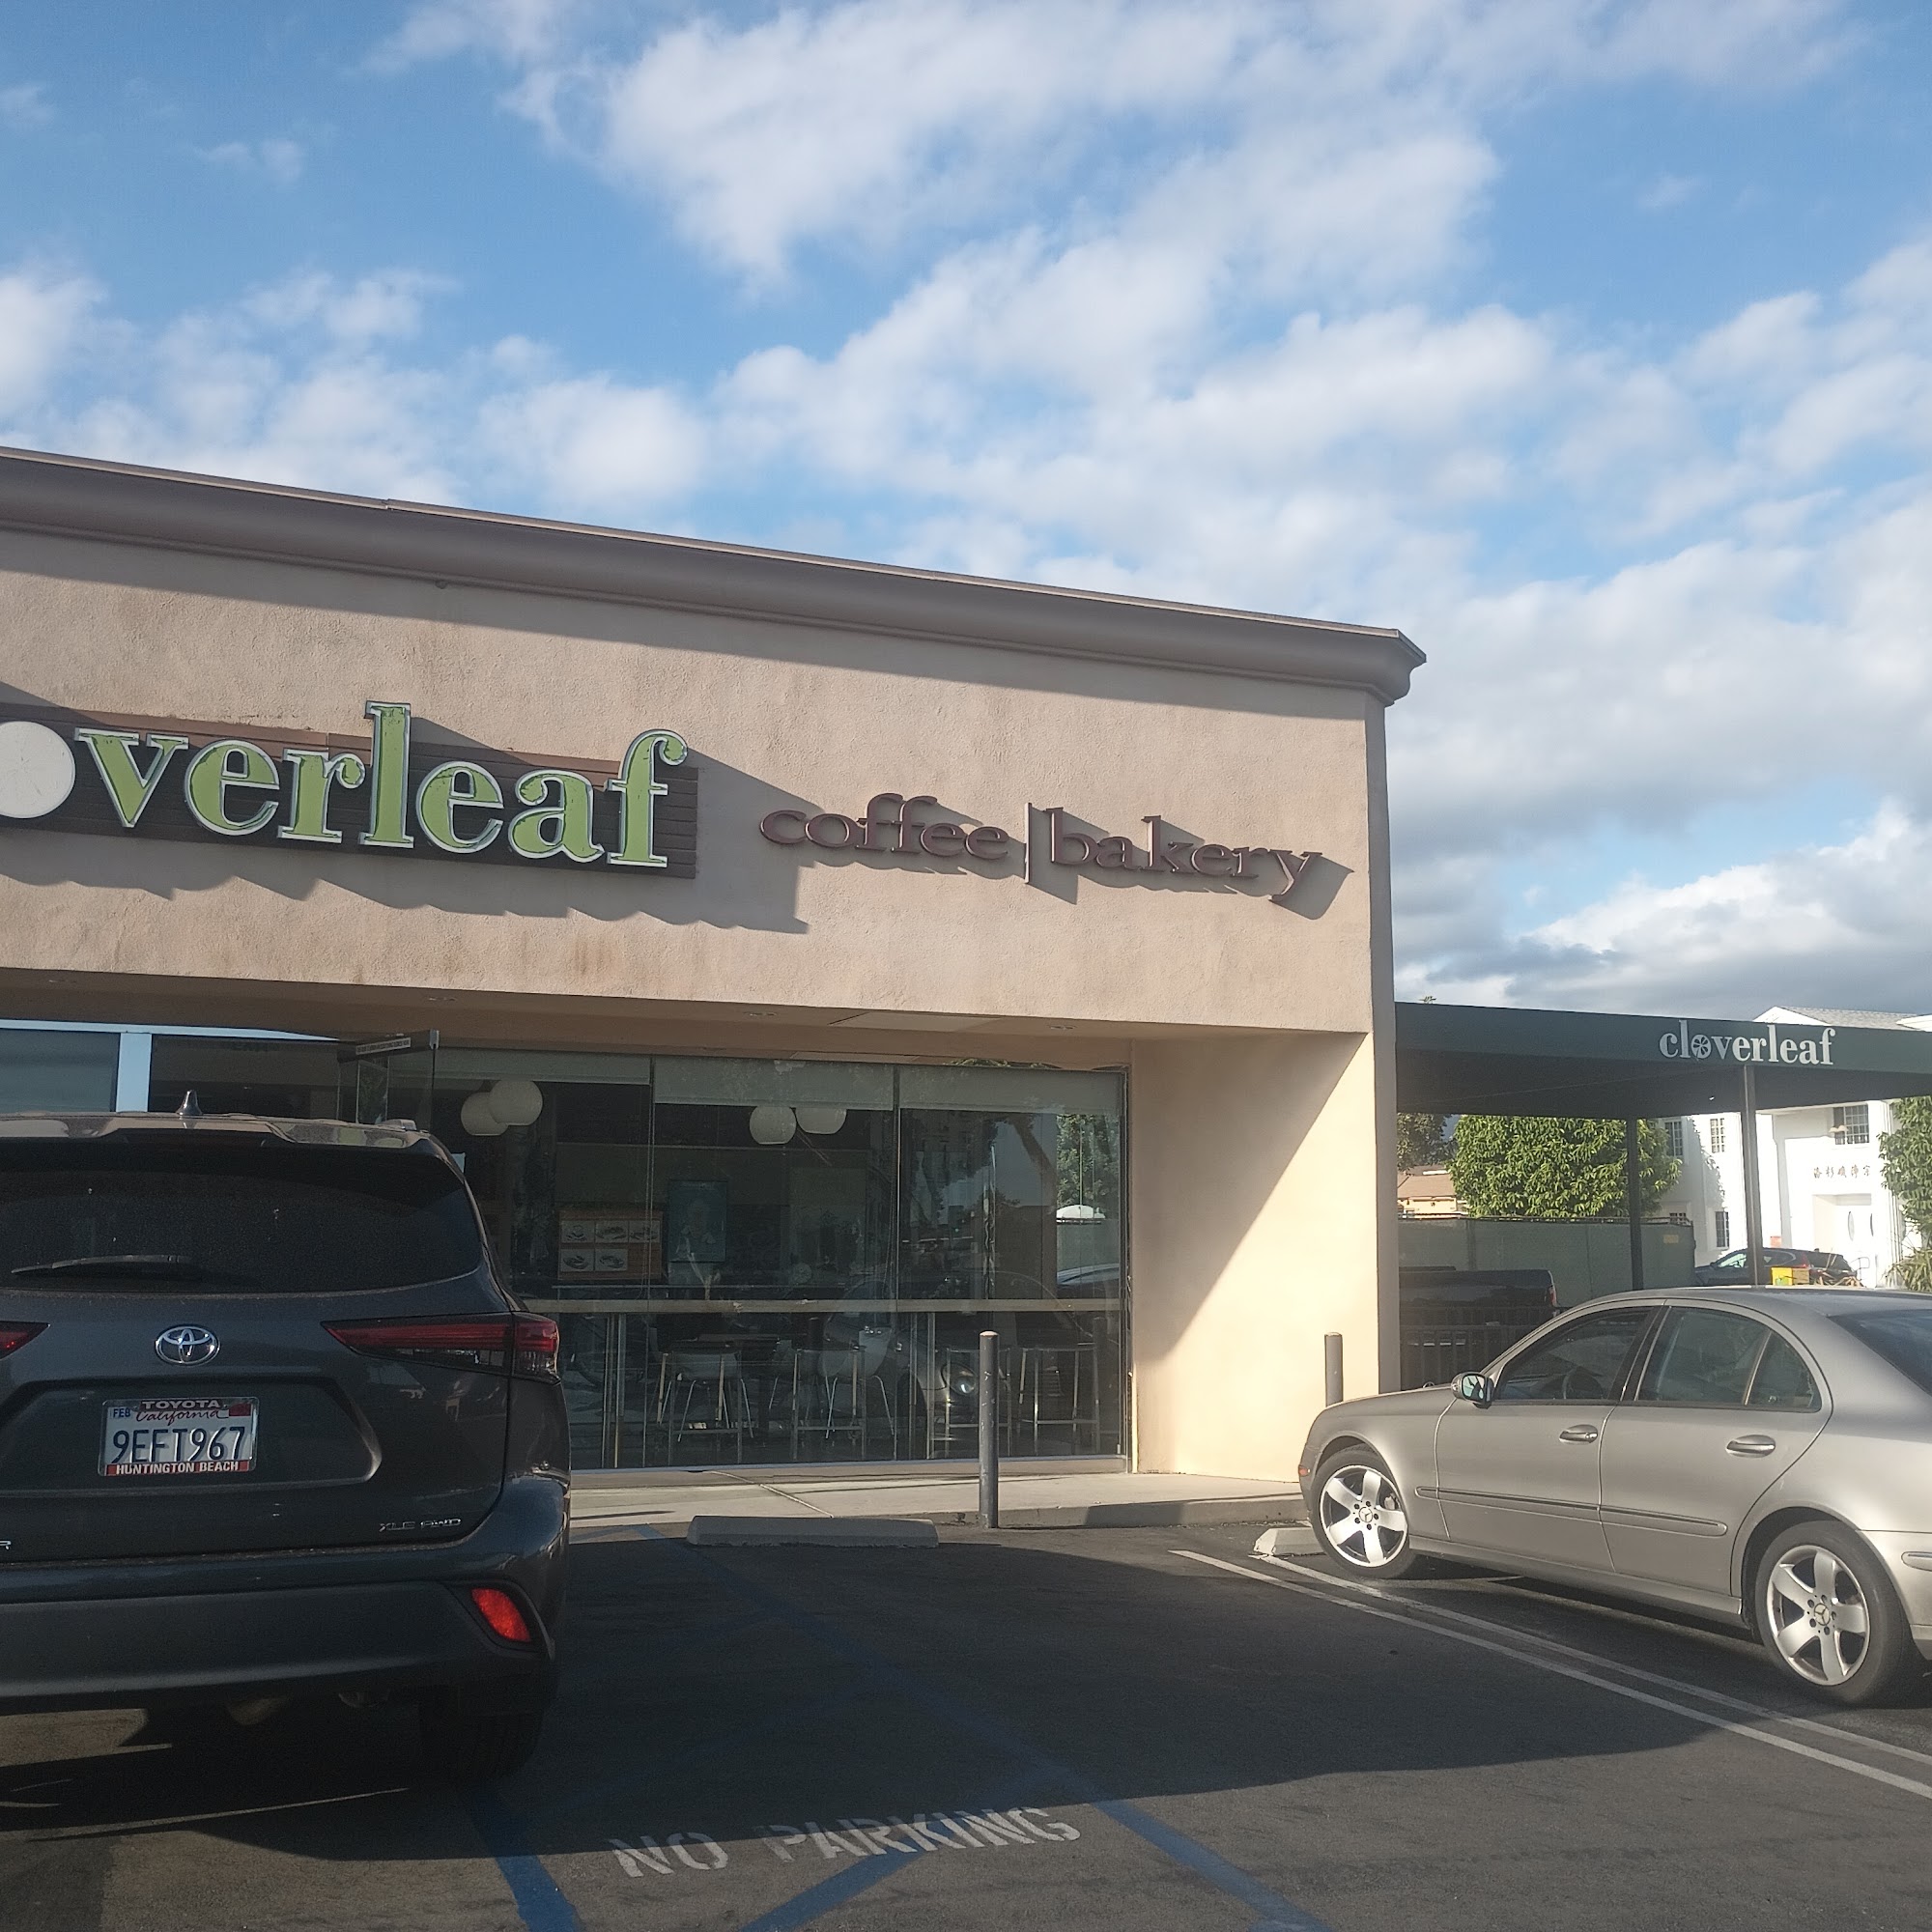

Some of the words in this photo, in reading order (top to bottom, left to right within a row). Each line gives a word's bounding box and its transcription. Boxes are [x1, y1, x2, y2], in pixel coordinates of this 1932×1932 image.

[759, 792, 1009, 862] coffee
[1044, 805, 1322, 903] bakery
[1659, 1019, 1836, 1065] cloverleaf
[135, 1410, 230, 1426] California
[142, 1400, 220, 1409] TOYOTA
[111, 1427, 245, 1463] 9EFT967
[116, 1463, 195, 1475] HUNTINGTON
[199, 1461, 239, 1472] BEACH
[610, 1833, 728, 1878] NO
[762, 1806, 1081, 1862] PARKING
